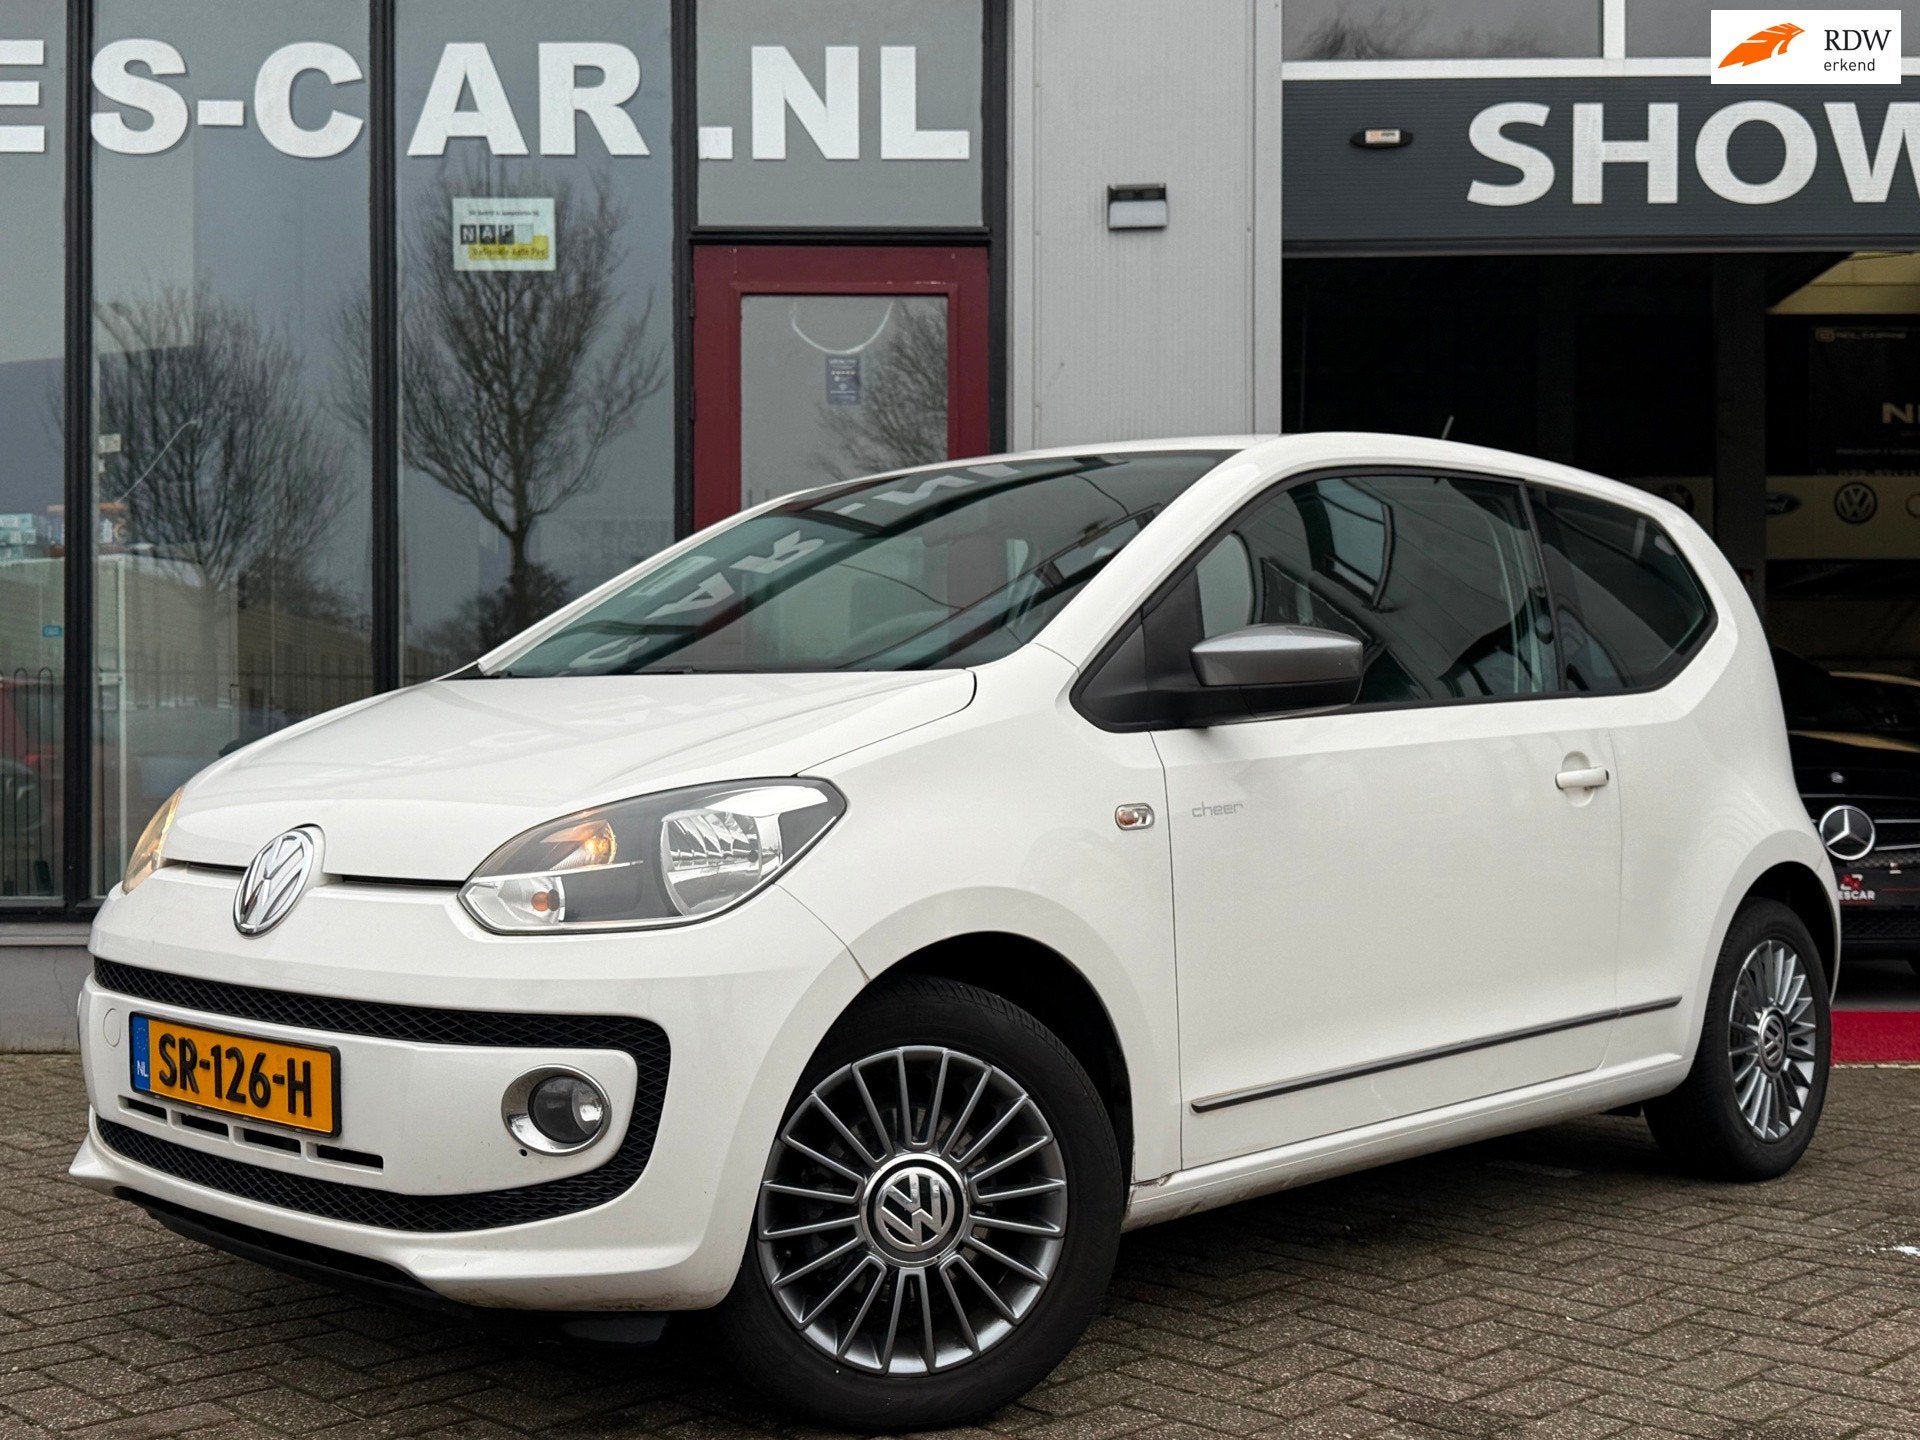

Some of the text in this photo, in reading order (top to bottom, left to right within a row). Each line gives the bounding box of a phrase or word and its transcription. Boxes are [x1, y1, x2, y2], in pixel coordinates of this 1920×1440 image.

[1192, 801, 1243, 818] cheer
[137, 1060, 149, 1078] NL
[158, 1032, 312, 1118] SR-126-H
